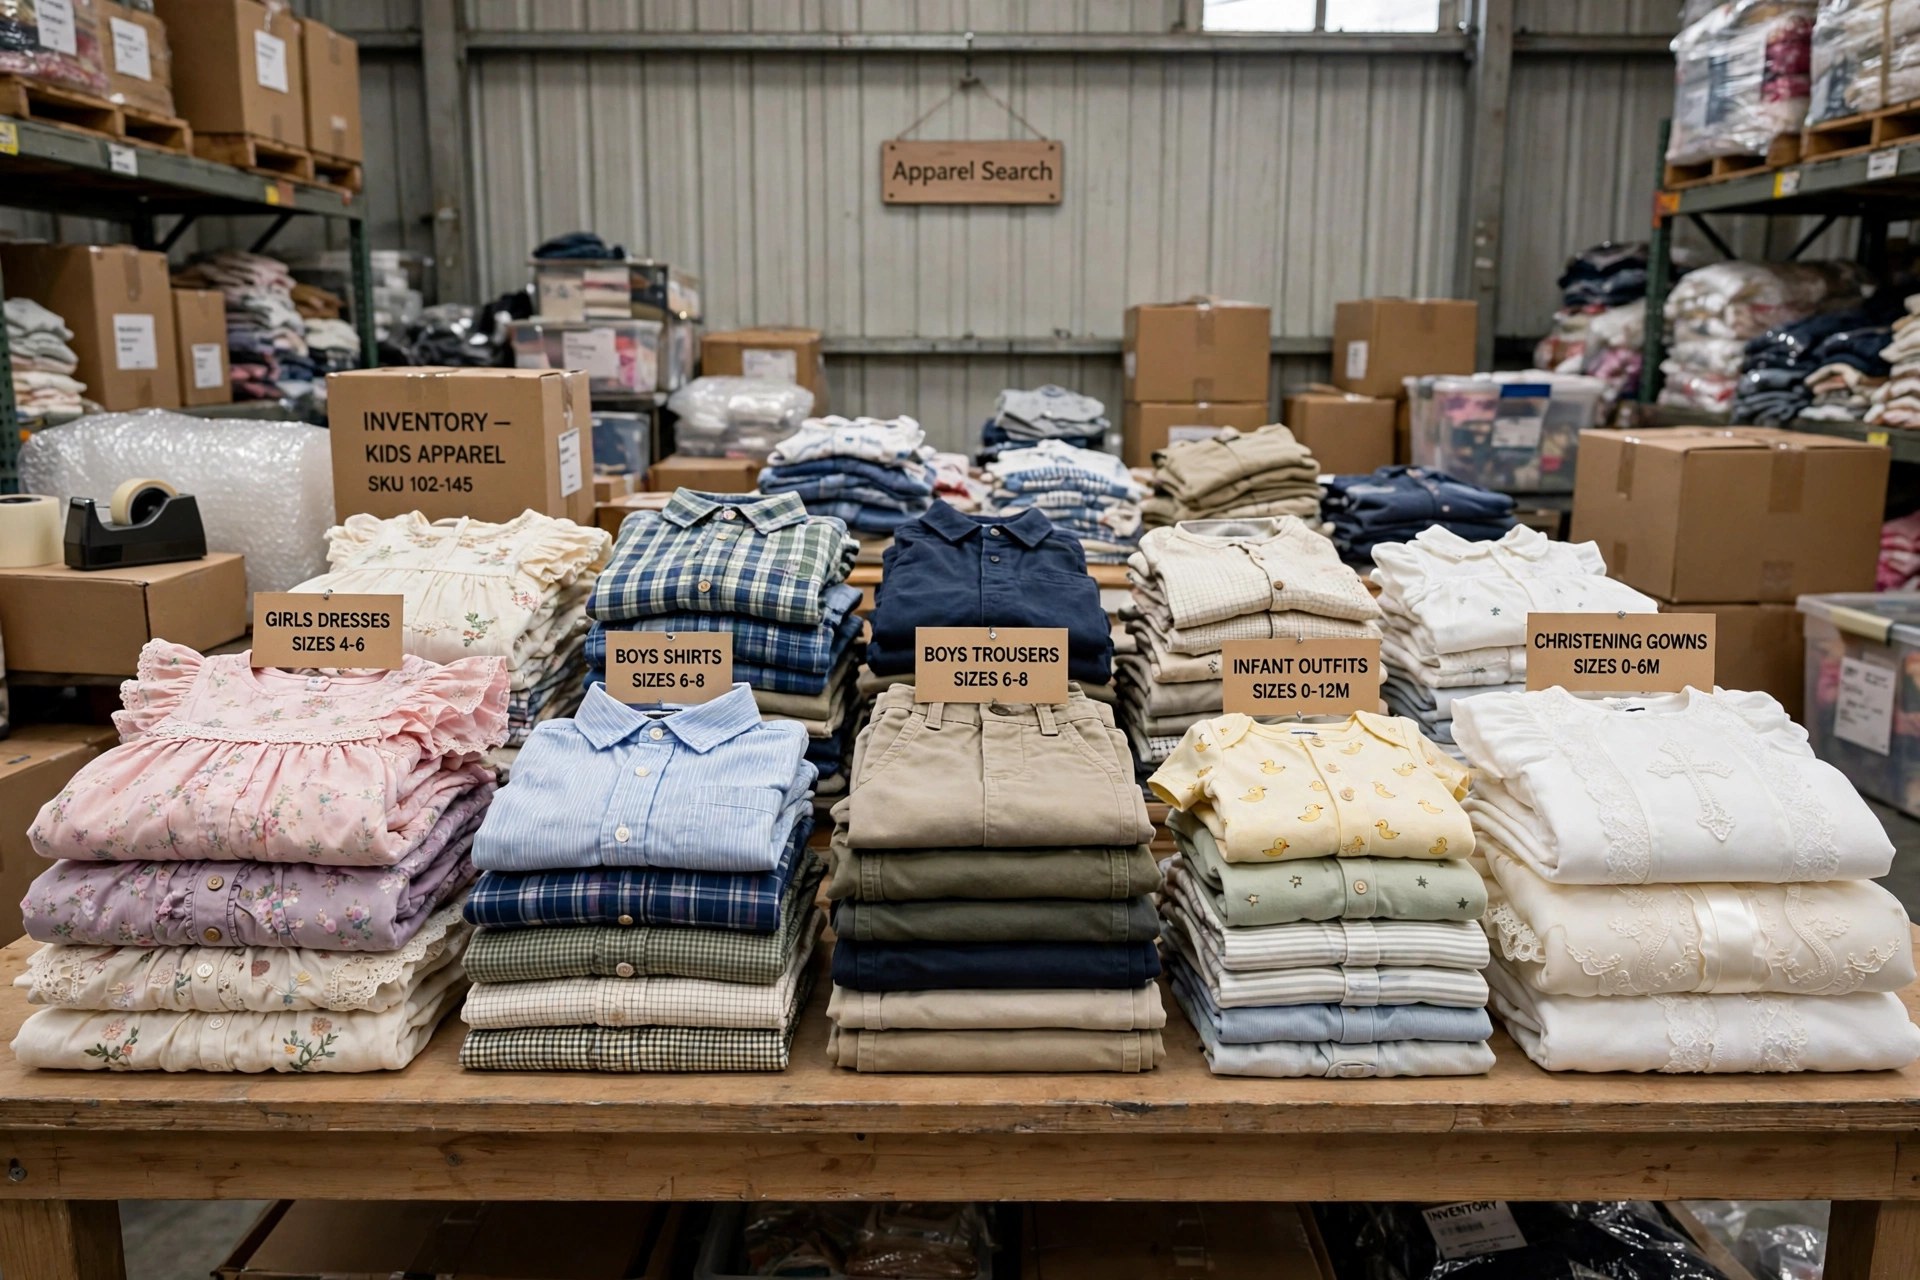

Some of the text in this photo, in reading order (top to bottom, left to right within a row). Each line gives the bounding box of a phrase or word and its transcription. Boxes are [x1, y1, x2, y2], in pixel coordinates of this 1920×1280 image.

[892, 160, 1053, 187] Apparel Search
[363, 411, 488, 432] INVENTORY
[365, 444, 506, 464] KIDS APPAREL
[368, 475, 473, 493] SKU 102-145
[265, 611, 391, 629] GIRLS DRESSES
[292, 635, 365, 652] SIZES 4-6
[1534, 632, 1708, 650] CHRISTENING GOWNS
[615, 648, 722, 665] BOYS SHIRTS
[924, 646, 1060, 663] BOYS TROUSERS
[1233, 657, 1369, 675] INFANT OUTFITS
[1573, 658, 1660, 675] SIZES 0-6M
[632, 672, 705, 688] SIZES 6-8
[953, 670, 1029, 687] SIZES 6-8
[1252, 682, 1350, 699] SIZES 0-12M
[1427, 1200, 1497, 1220] INVENTORY
